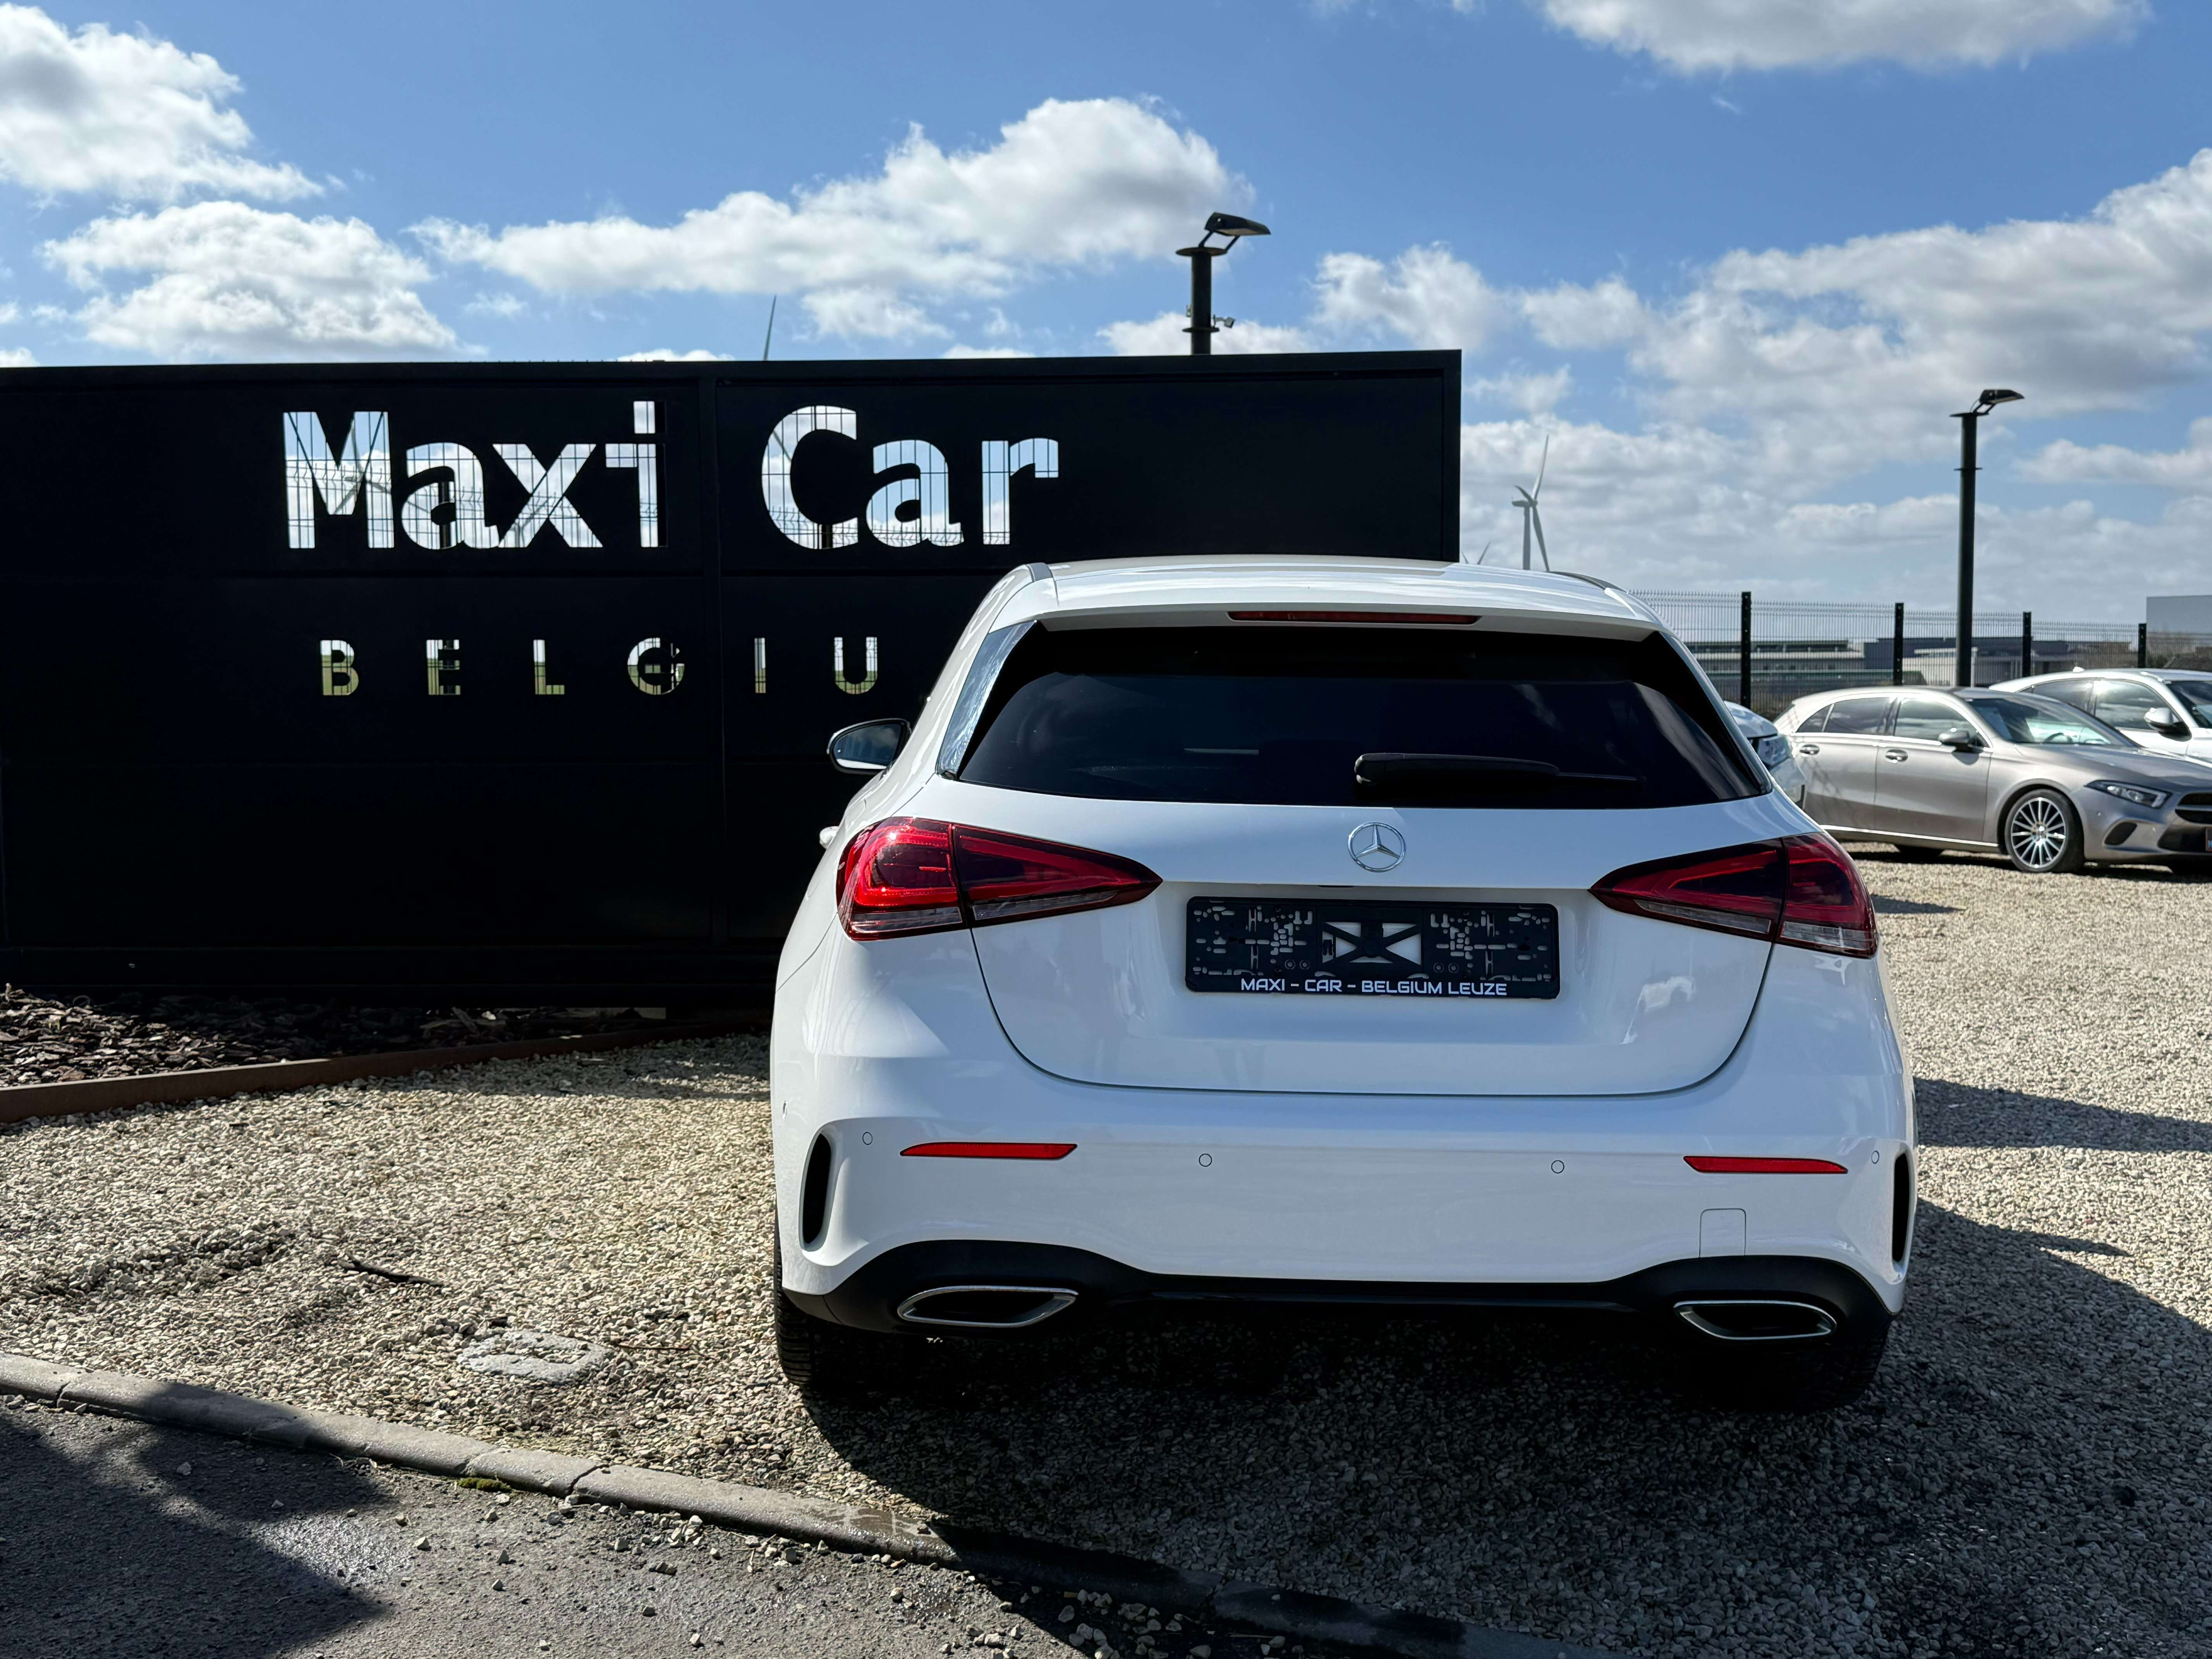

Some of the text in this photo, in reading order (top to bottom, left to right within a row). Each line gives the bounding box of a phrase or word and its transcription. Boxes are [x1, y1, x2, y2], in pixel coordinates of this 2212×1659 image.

[282, 400, 1059, 550] Maxi Car
[319, 636, 878, 696] BELGIU
[1241, 978, 1285, 991] MAXI
[1305, 979, 1343, 992] CAR
[1361, 980, 1442, 994] BELGIUM
[1448, 982, 1507, 996] LEUZE
